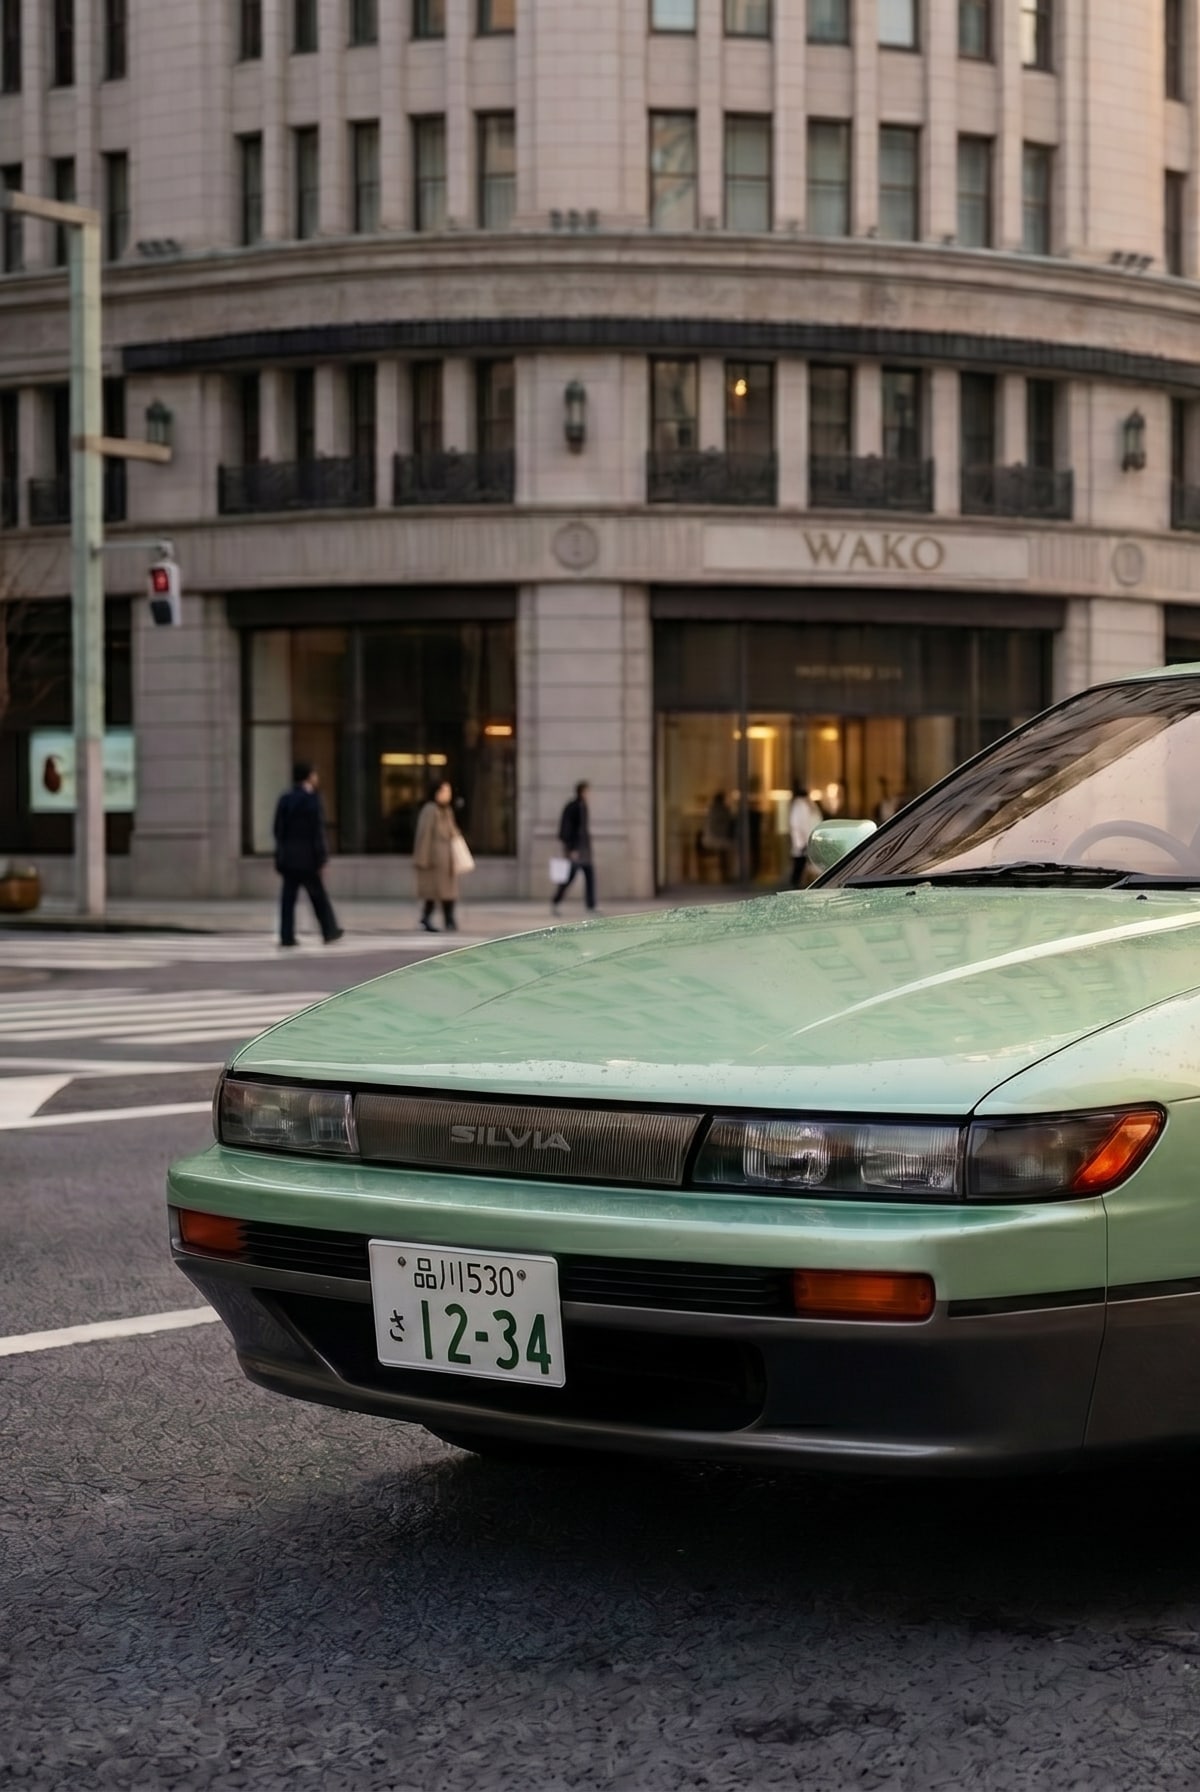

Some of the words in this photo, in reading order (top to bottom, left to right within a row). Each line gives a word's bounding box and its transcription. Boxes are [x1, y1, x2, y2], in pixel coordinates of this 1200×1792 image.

[803, 531, 946, 571] WAKO
[450, 1125, 571, 1151] SILVIA
[389, 1310, 405, 1342] さ
[421, 1300, 552, 1375] 12-34
